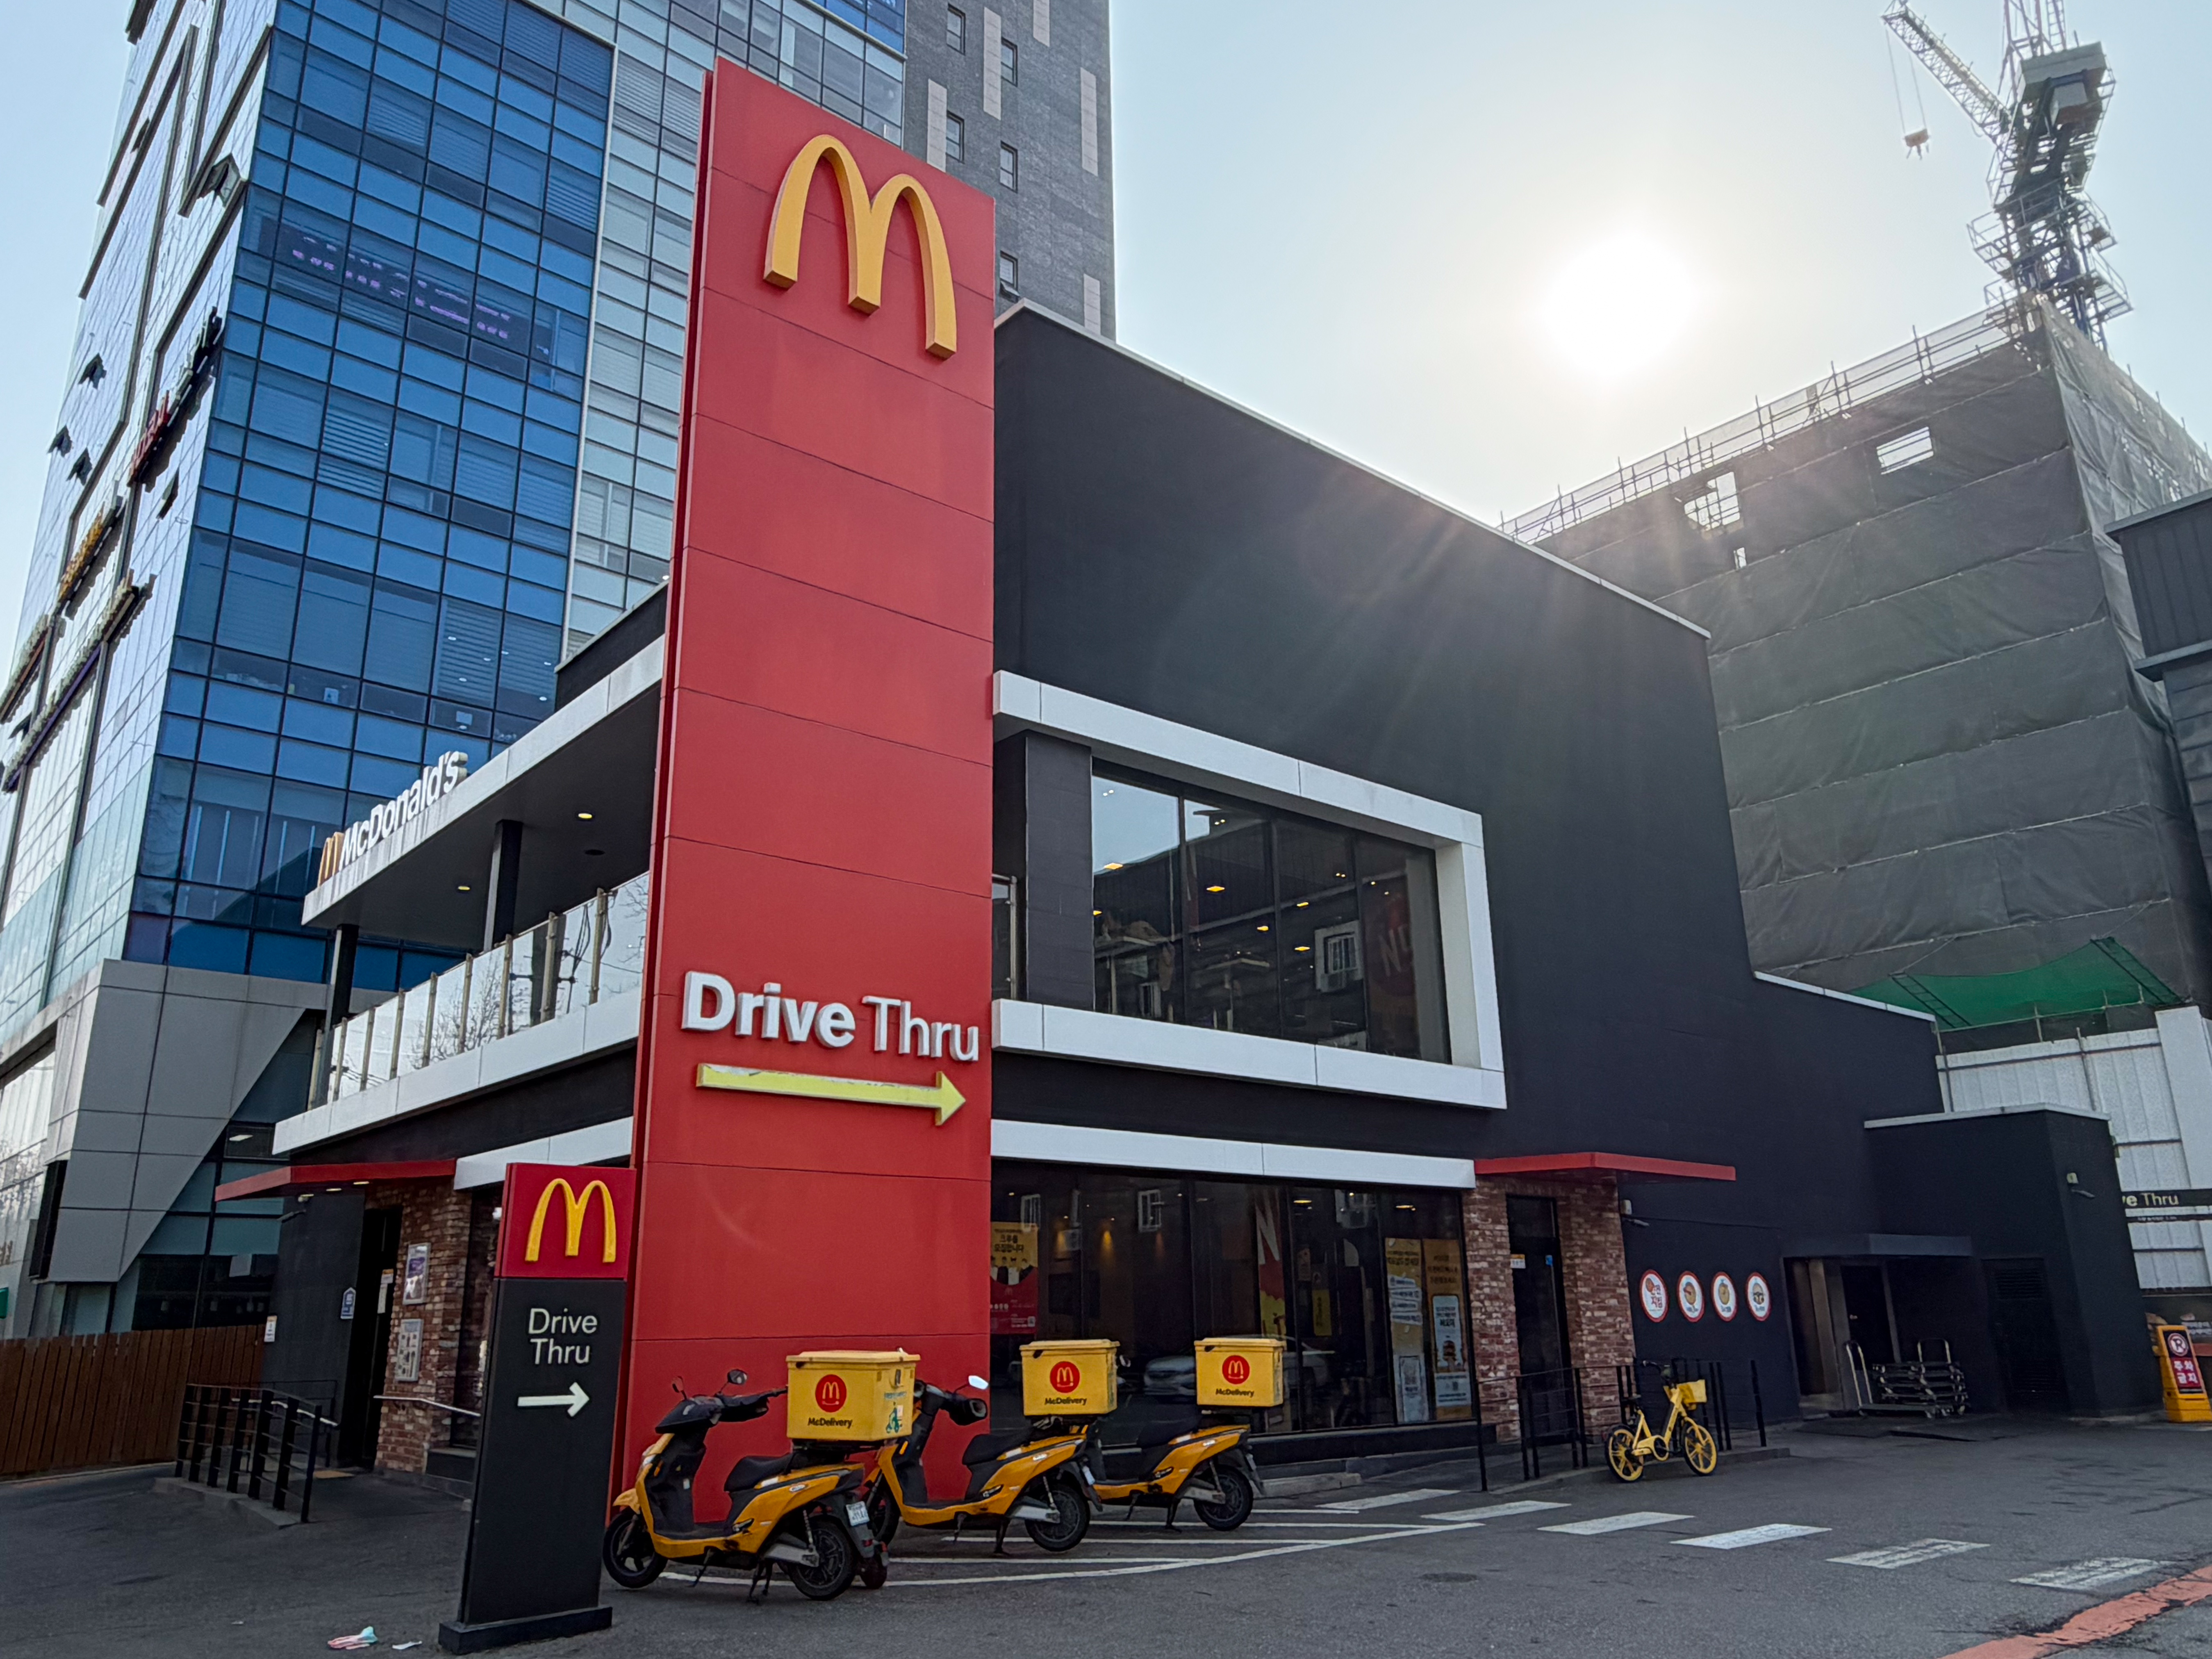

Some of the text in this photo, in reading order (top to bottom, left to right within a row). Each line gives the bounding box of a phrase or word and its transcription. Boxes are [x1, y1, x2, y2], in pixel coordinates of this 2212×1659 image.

[339, 751, 468, 871] McDonald's
[681, 971, 979, 1061] Drive Thru
[2140, 1192, 2179, 1206] Thru
[528, 1308, 598, 1334] Drive
[530, 1338, 590, 1364] Thru
[1045, 1396, 1087, 1406] McDelivery
[1215, 1388, 1254, 1398] McDelivery
[808, 1417, 853, 1429] McDelivery
